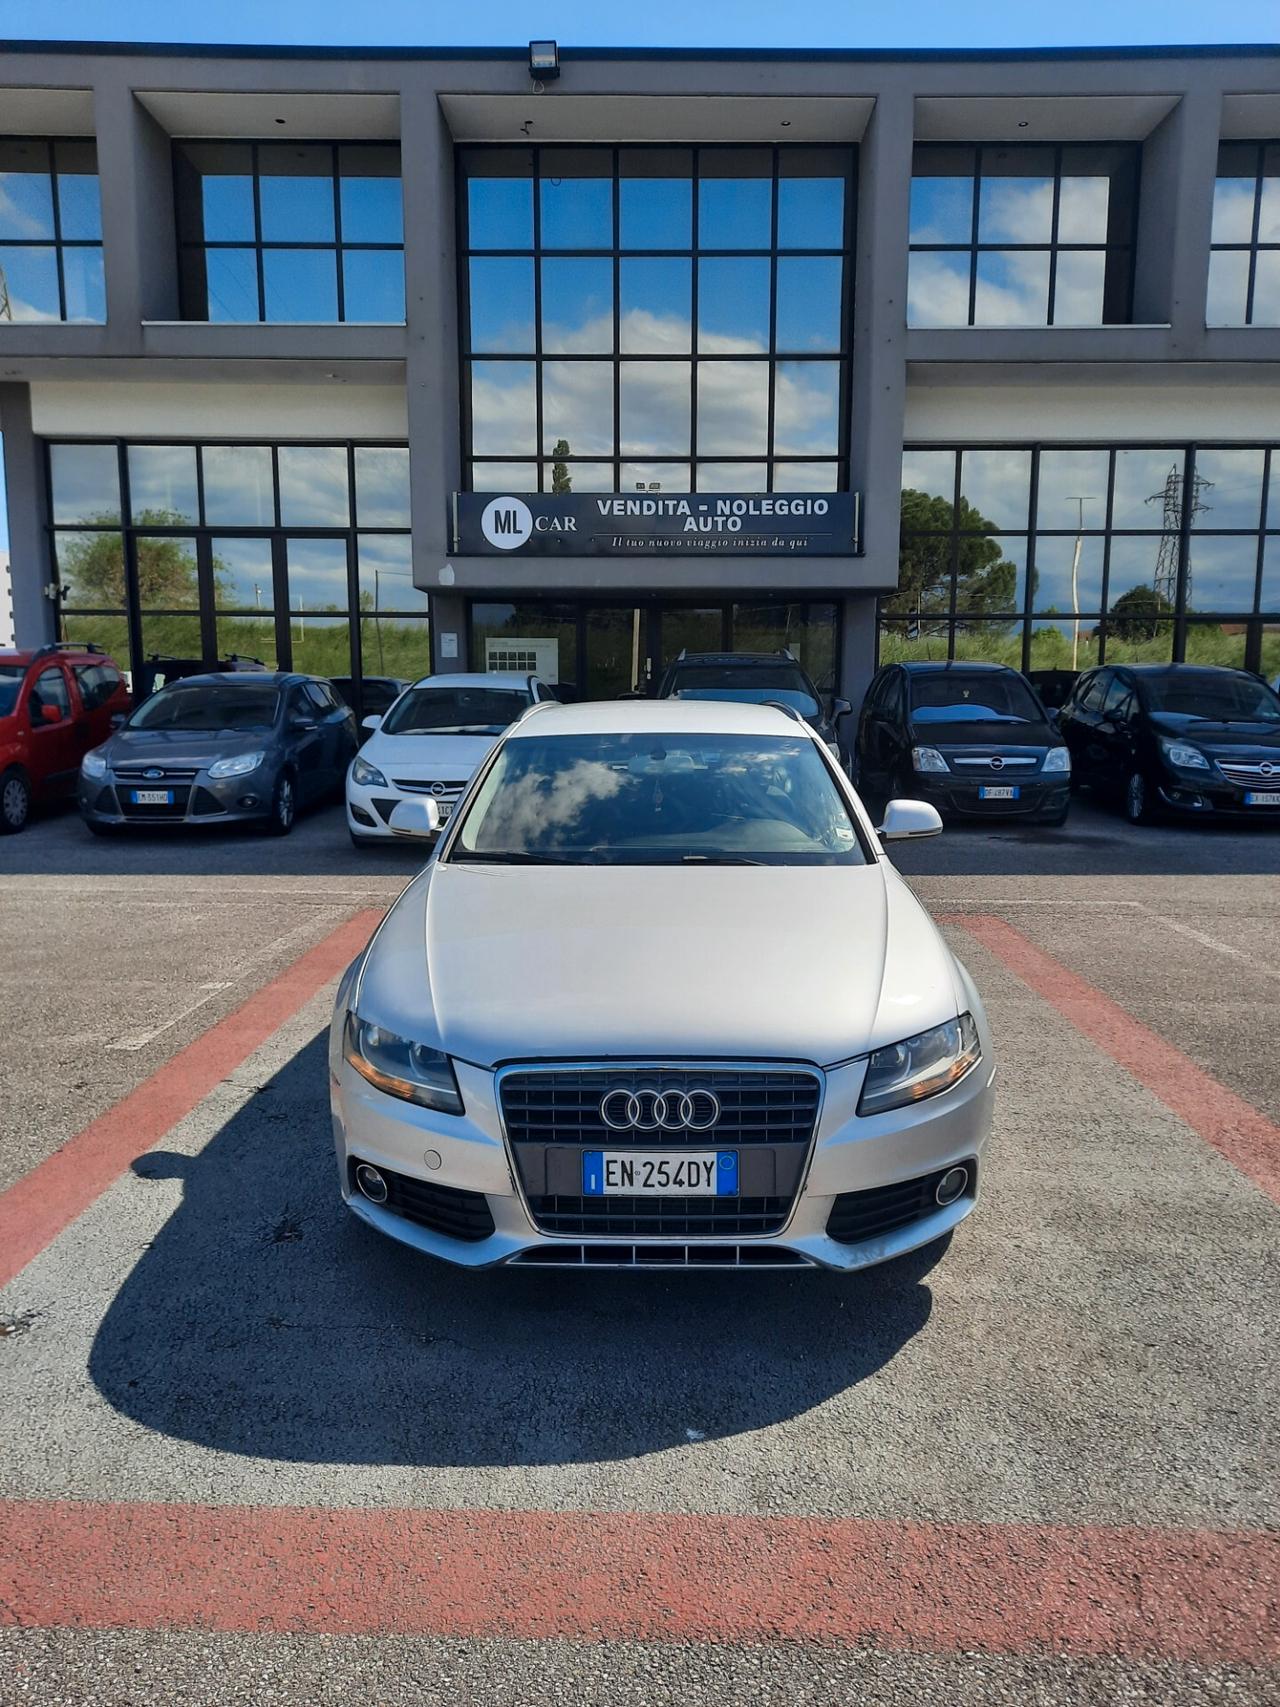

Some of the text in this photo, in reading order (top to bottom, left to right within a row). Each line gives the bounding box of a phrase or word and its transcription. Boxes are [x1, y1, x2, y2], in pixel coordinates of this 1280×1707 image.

[597, 499, 691, 515] VENDITA
[717, 499, 828, 515] NOLEGGIO
[494, 510, 577, 534] ML CAR
[683, 516, 742, 532] AUTO
[612, 537, 808, 550] Il tuo nuovo viaggio inizia da qui
[642, 1160, 715, 1188] 254DY
